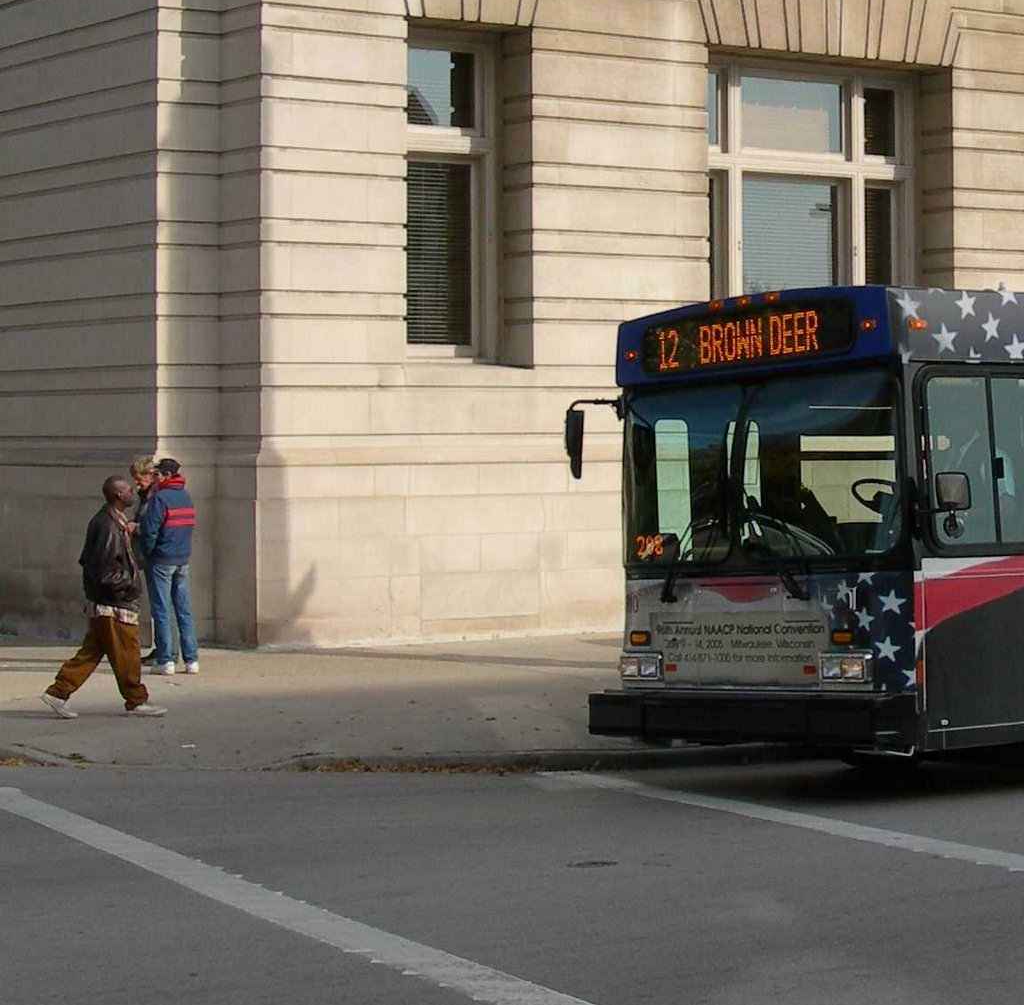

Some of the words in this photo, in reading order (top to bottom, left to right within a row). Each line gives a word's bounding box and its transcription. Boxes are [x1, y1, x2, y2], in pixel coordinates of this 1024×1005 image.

[659, 330, 679, 369] 12
[700, 321, 762, 364] BROWN
[770, 310, 818, 356] DEER
[704, 624, 735, 635] NAACP
[736, 623, 772, 635] National
[773, 622, 825, 635] Convention
